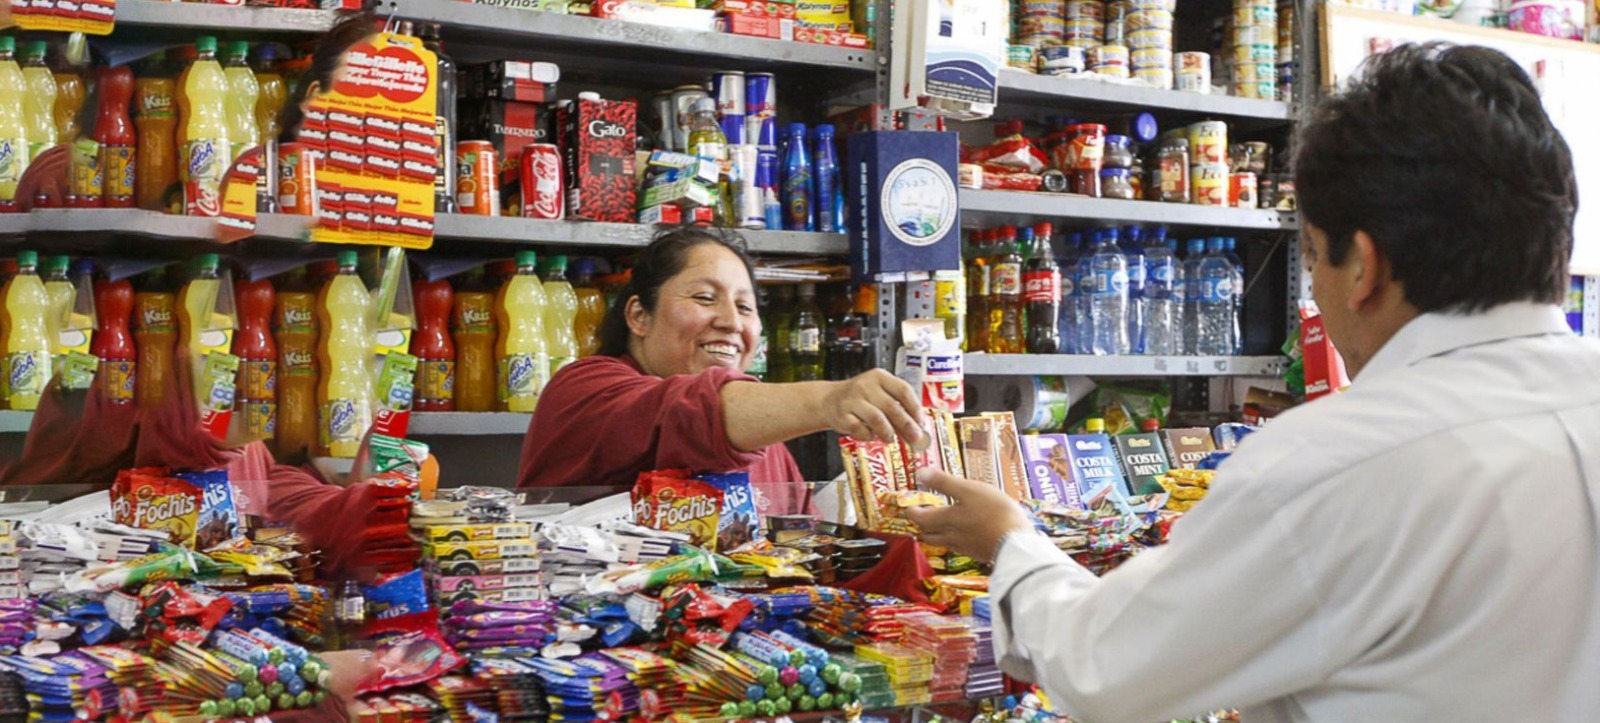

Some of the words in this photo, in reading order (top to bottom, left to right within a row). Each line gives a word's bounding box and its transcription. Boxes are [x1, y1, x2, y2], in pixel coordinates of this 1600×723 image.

[588, 120, 627, 138] Gato
[1076, 456, 1113, 468] COSTA
[1127, 452, 1163, 466] COSTA
[1082, 467, 1115, 479] MILK
[1133, 464, 1164, 476] MINT
[132, 492, 197, 528] Fochis
[652, 494, 717, 530] Fochis
